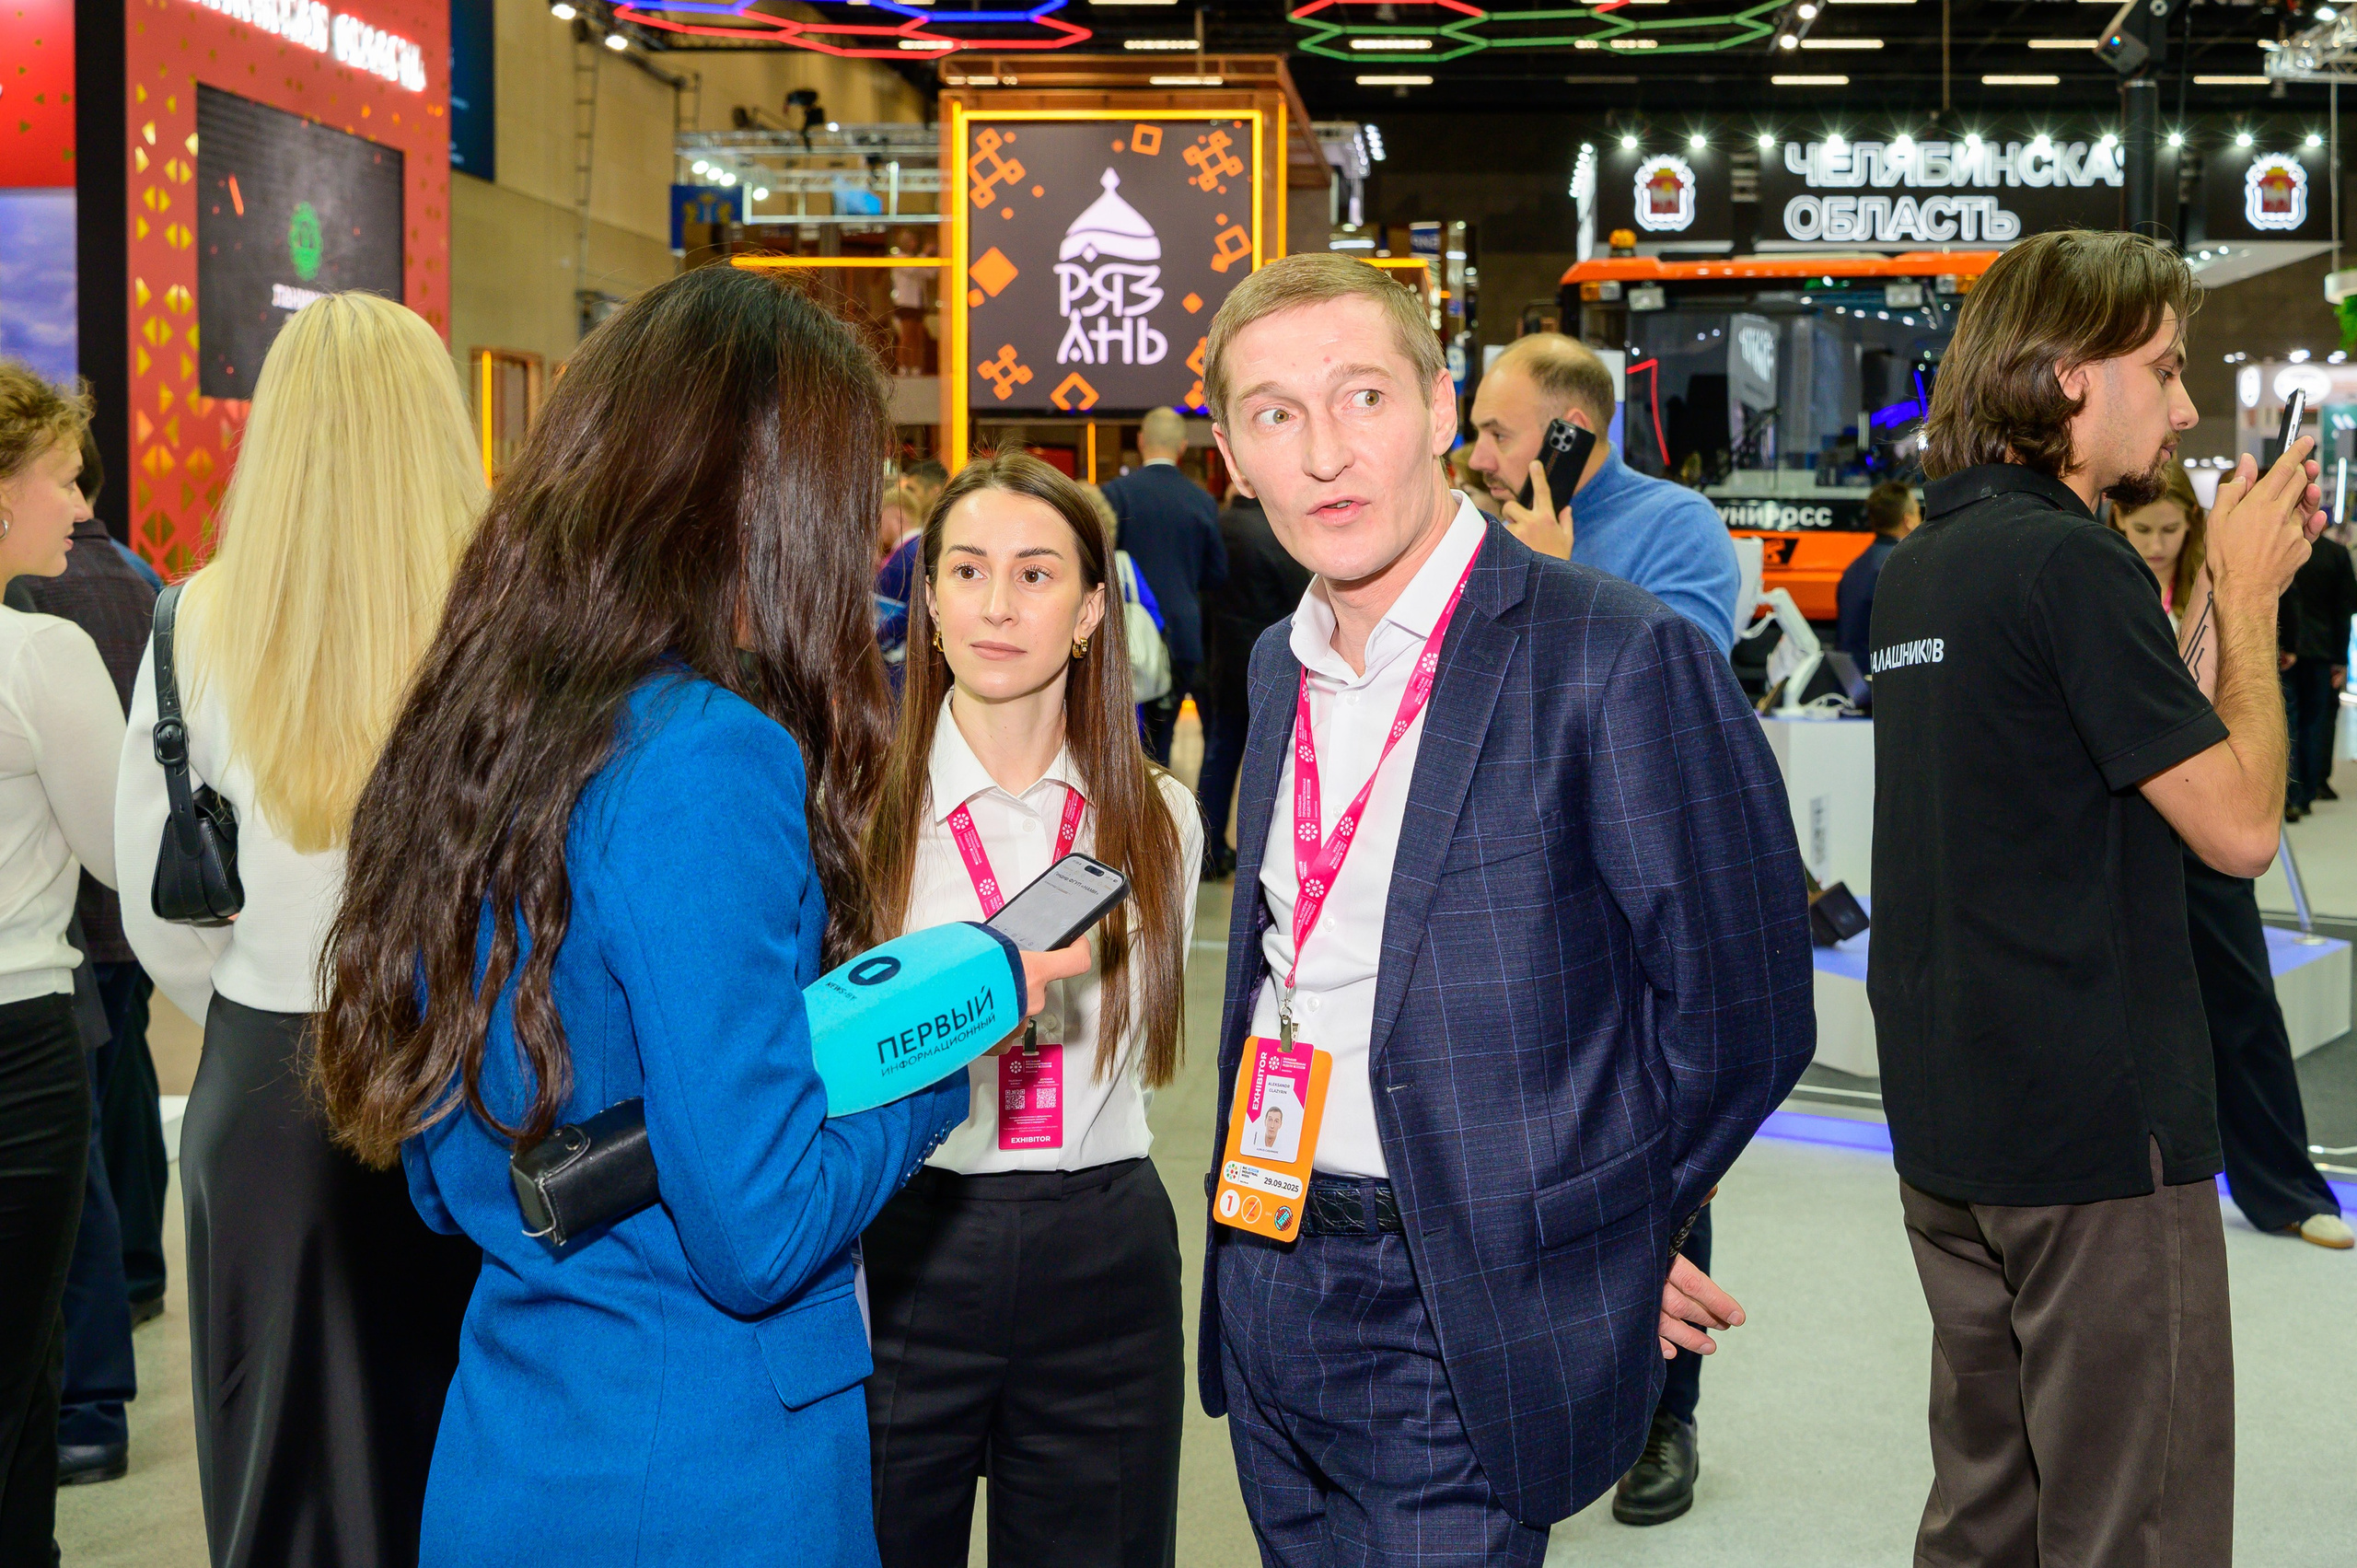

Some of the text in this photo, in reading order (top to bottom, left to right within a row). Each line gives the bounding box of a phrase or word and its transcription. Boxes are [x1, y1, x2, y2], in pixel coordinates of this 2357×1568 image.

[1784, 141, 2125, 187] ЧЕЛЯБИНСКА
[1783, 194, 2021, 241] ОБЛАСТЬ
[1052, 262, 1165, 318] РЯЗ
[1056, 308, 1168, 366] АНЬ
[1870, 637, 1945, 674] АЛАШНИКОВ
[877, 985, 994, 1064] ПЕРВЫЙ
[881, 1013, 996, 1077] ИНФОРМАЦИОННЫЙ
[1252, 1051, 1268, 1110] EXHIBITOR
[1011, 1135, 1051, 1144] EXHIBITOR
[1227, 1194, 1233, 1212] 1
[1263, 1177, 1299, 1192] 29.09.2025
